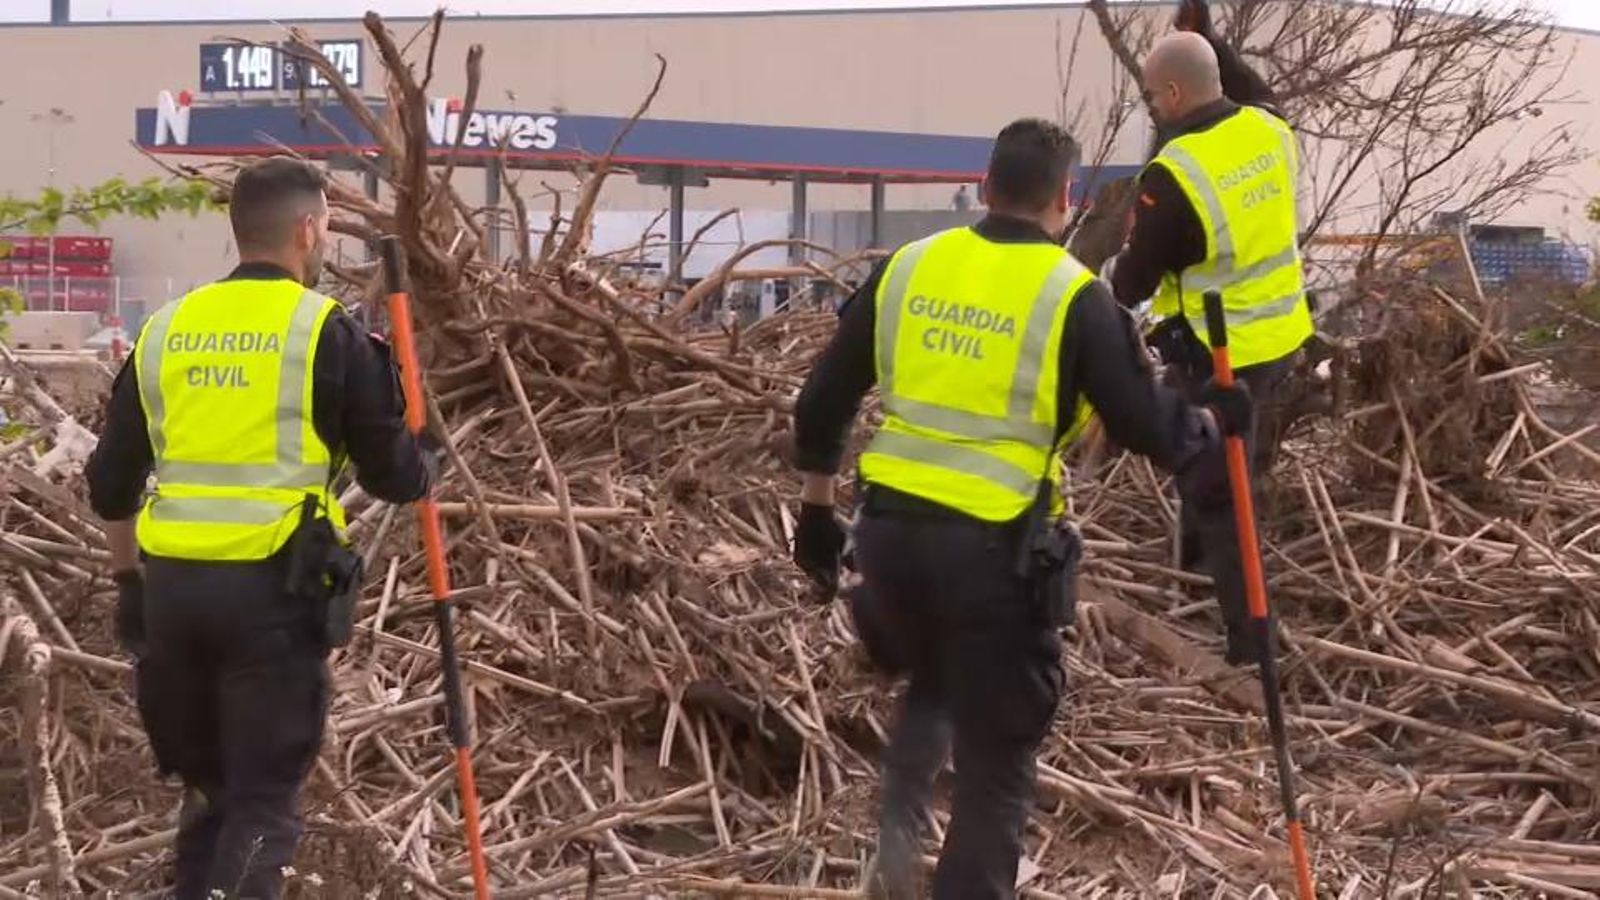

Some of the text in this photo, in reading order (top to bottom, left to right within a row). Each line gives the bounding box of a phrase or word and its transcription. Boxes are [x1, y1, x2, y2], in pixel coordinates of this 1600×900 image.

[222, 46, 272, 87] 1.449
[154, 89, 190, 146] N
[426, 98, 558, 149] Nieves
[908, 294, 1015, 339] GUARDIA
[167, 331, 280, 353] GUARDIA
[922, 327, 984, 360] CIVIL
[186, 366, 250, 388] CIVIL
